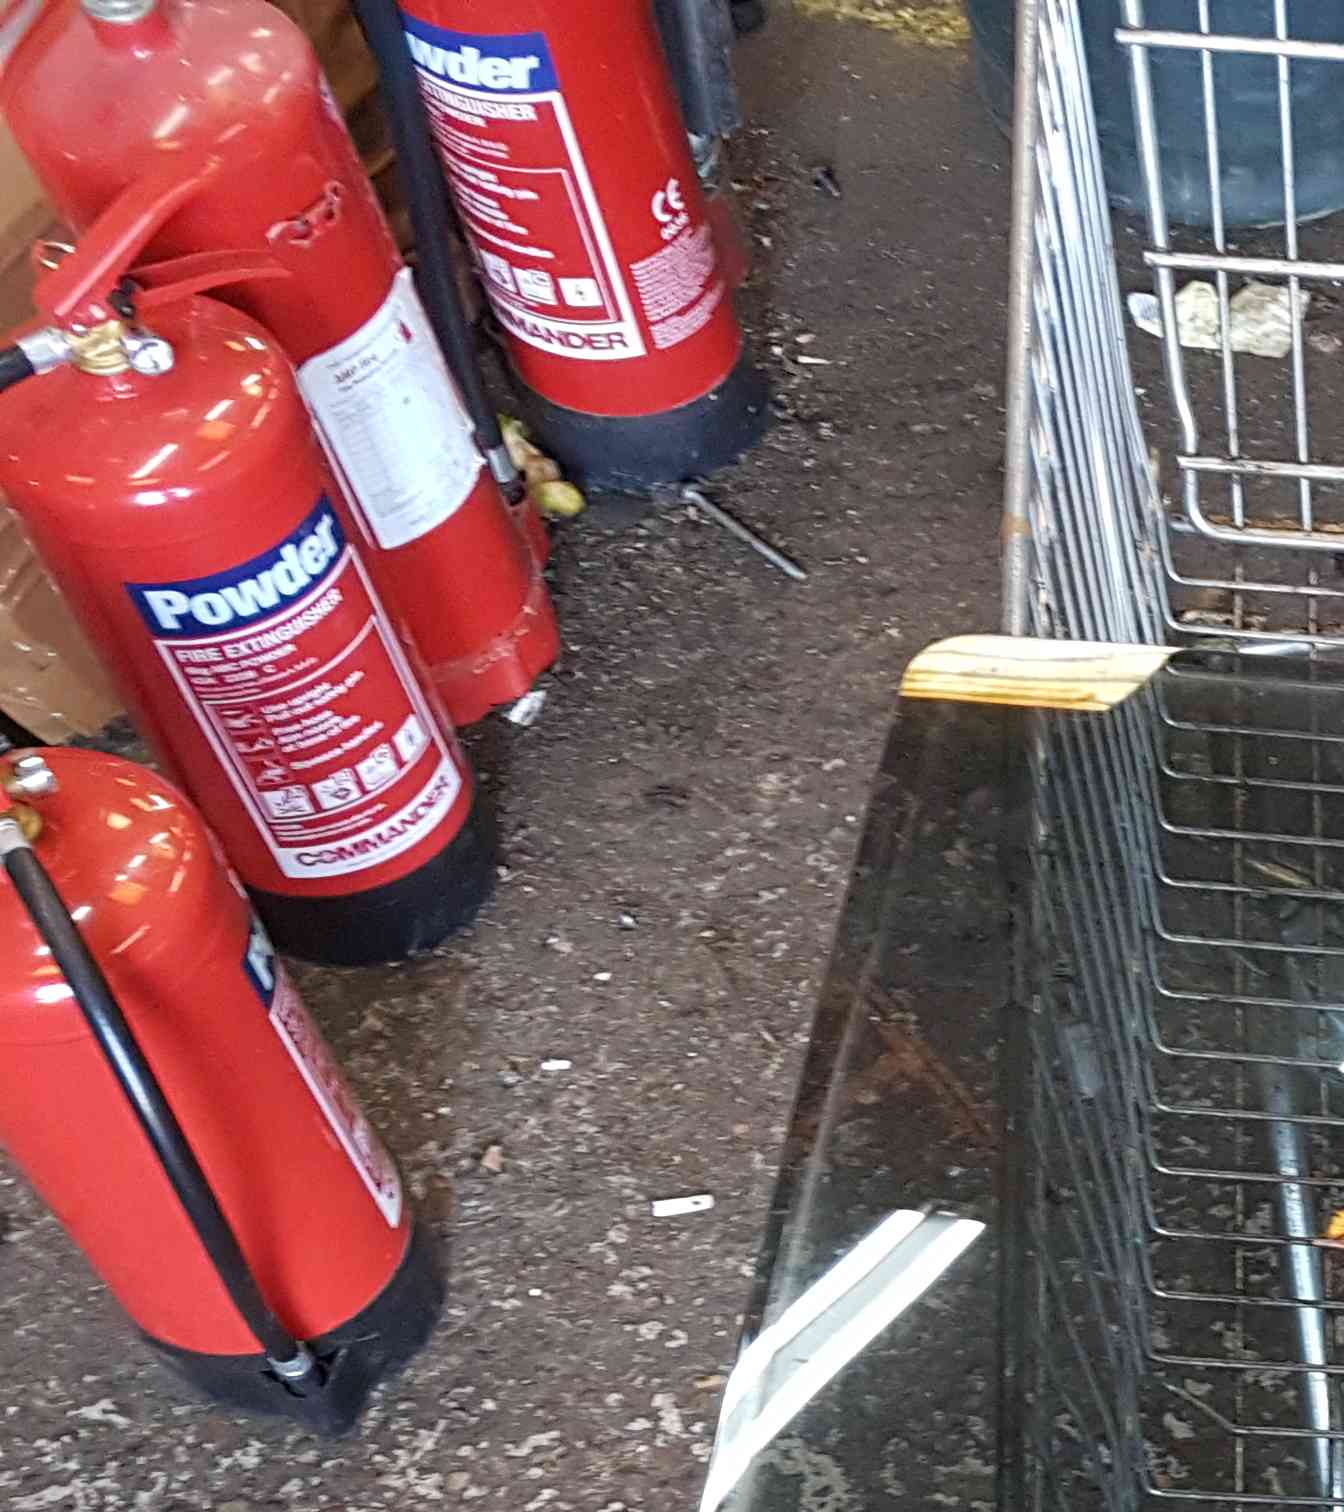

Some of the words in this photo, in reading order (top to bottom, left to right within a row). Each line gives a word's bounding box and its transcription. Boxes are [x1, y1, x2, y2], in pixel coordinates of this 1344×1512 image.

[404, 31, 541, 90] wder
[143, 513, 339, 630] Powder
[174, 647, 225, 663] FIRE
[221, 587, 344, 659] EXTINGUISHER
